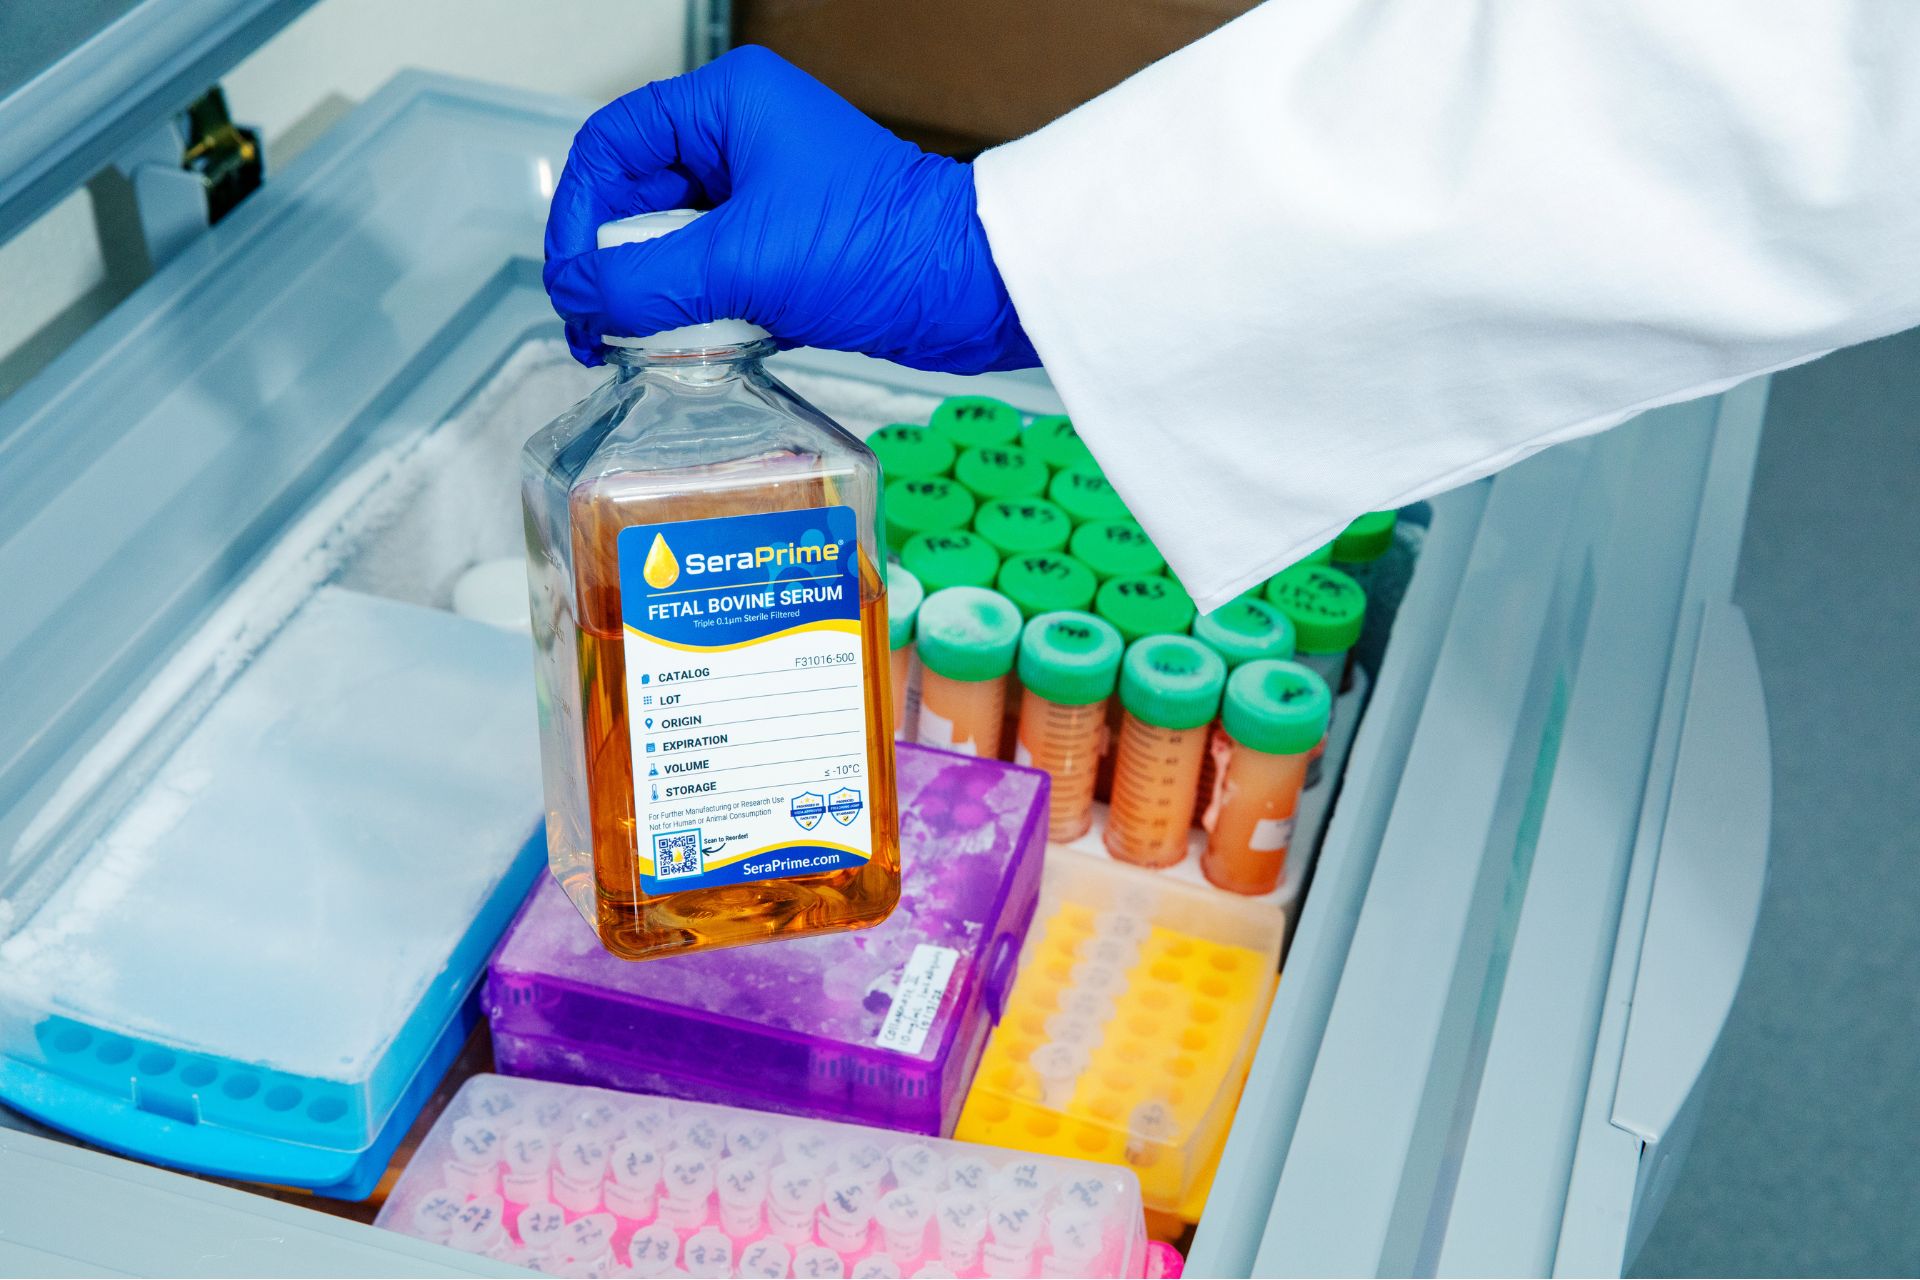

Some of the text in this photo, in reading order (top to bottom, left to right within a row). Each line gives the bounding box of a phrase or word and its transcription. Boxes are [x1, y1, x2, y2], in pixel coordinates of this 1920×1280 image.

[648, 585, 843, 620] FETAL BOVINE SERUM
[693, 618, 715, 629] Triple
[743, 612, 769, 622] Sterile
[770, 609, 800, 620] Filtered
[658, 652, 855, 683] CATALOG F31016-500
[660, 694, 681, 706] LOT
[661, 715, 702, 729] ORIGIN
[663, 734, 728, 751] EXPIRATION
[664, 759, 710, 775] VOLUME
[665, 781, 717, 797] STORAGE
[648, 813, 659, 821] For
[660, 809, 684, 819] Further
[685, 804, 732, 816] Manufacturing
[741, 799, 771, 808] Research
[771, 796, 785, 804] Use
[649, 823, 662, 831] Not
[662, 820, 672, 829] for
[673, 818, 697, 828] Human
[706, 814, 728, 823] Animal
[729, 808, 772, 820] Consumption
[703, 837, 718, 845] Scan
[743, 853, 840, 876] SeraPrime.com
